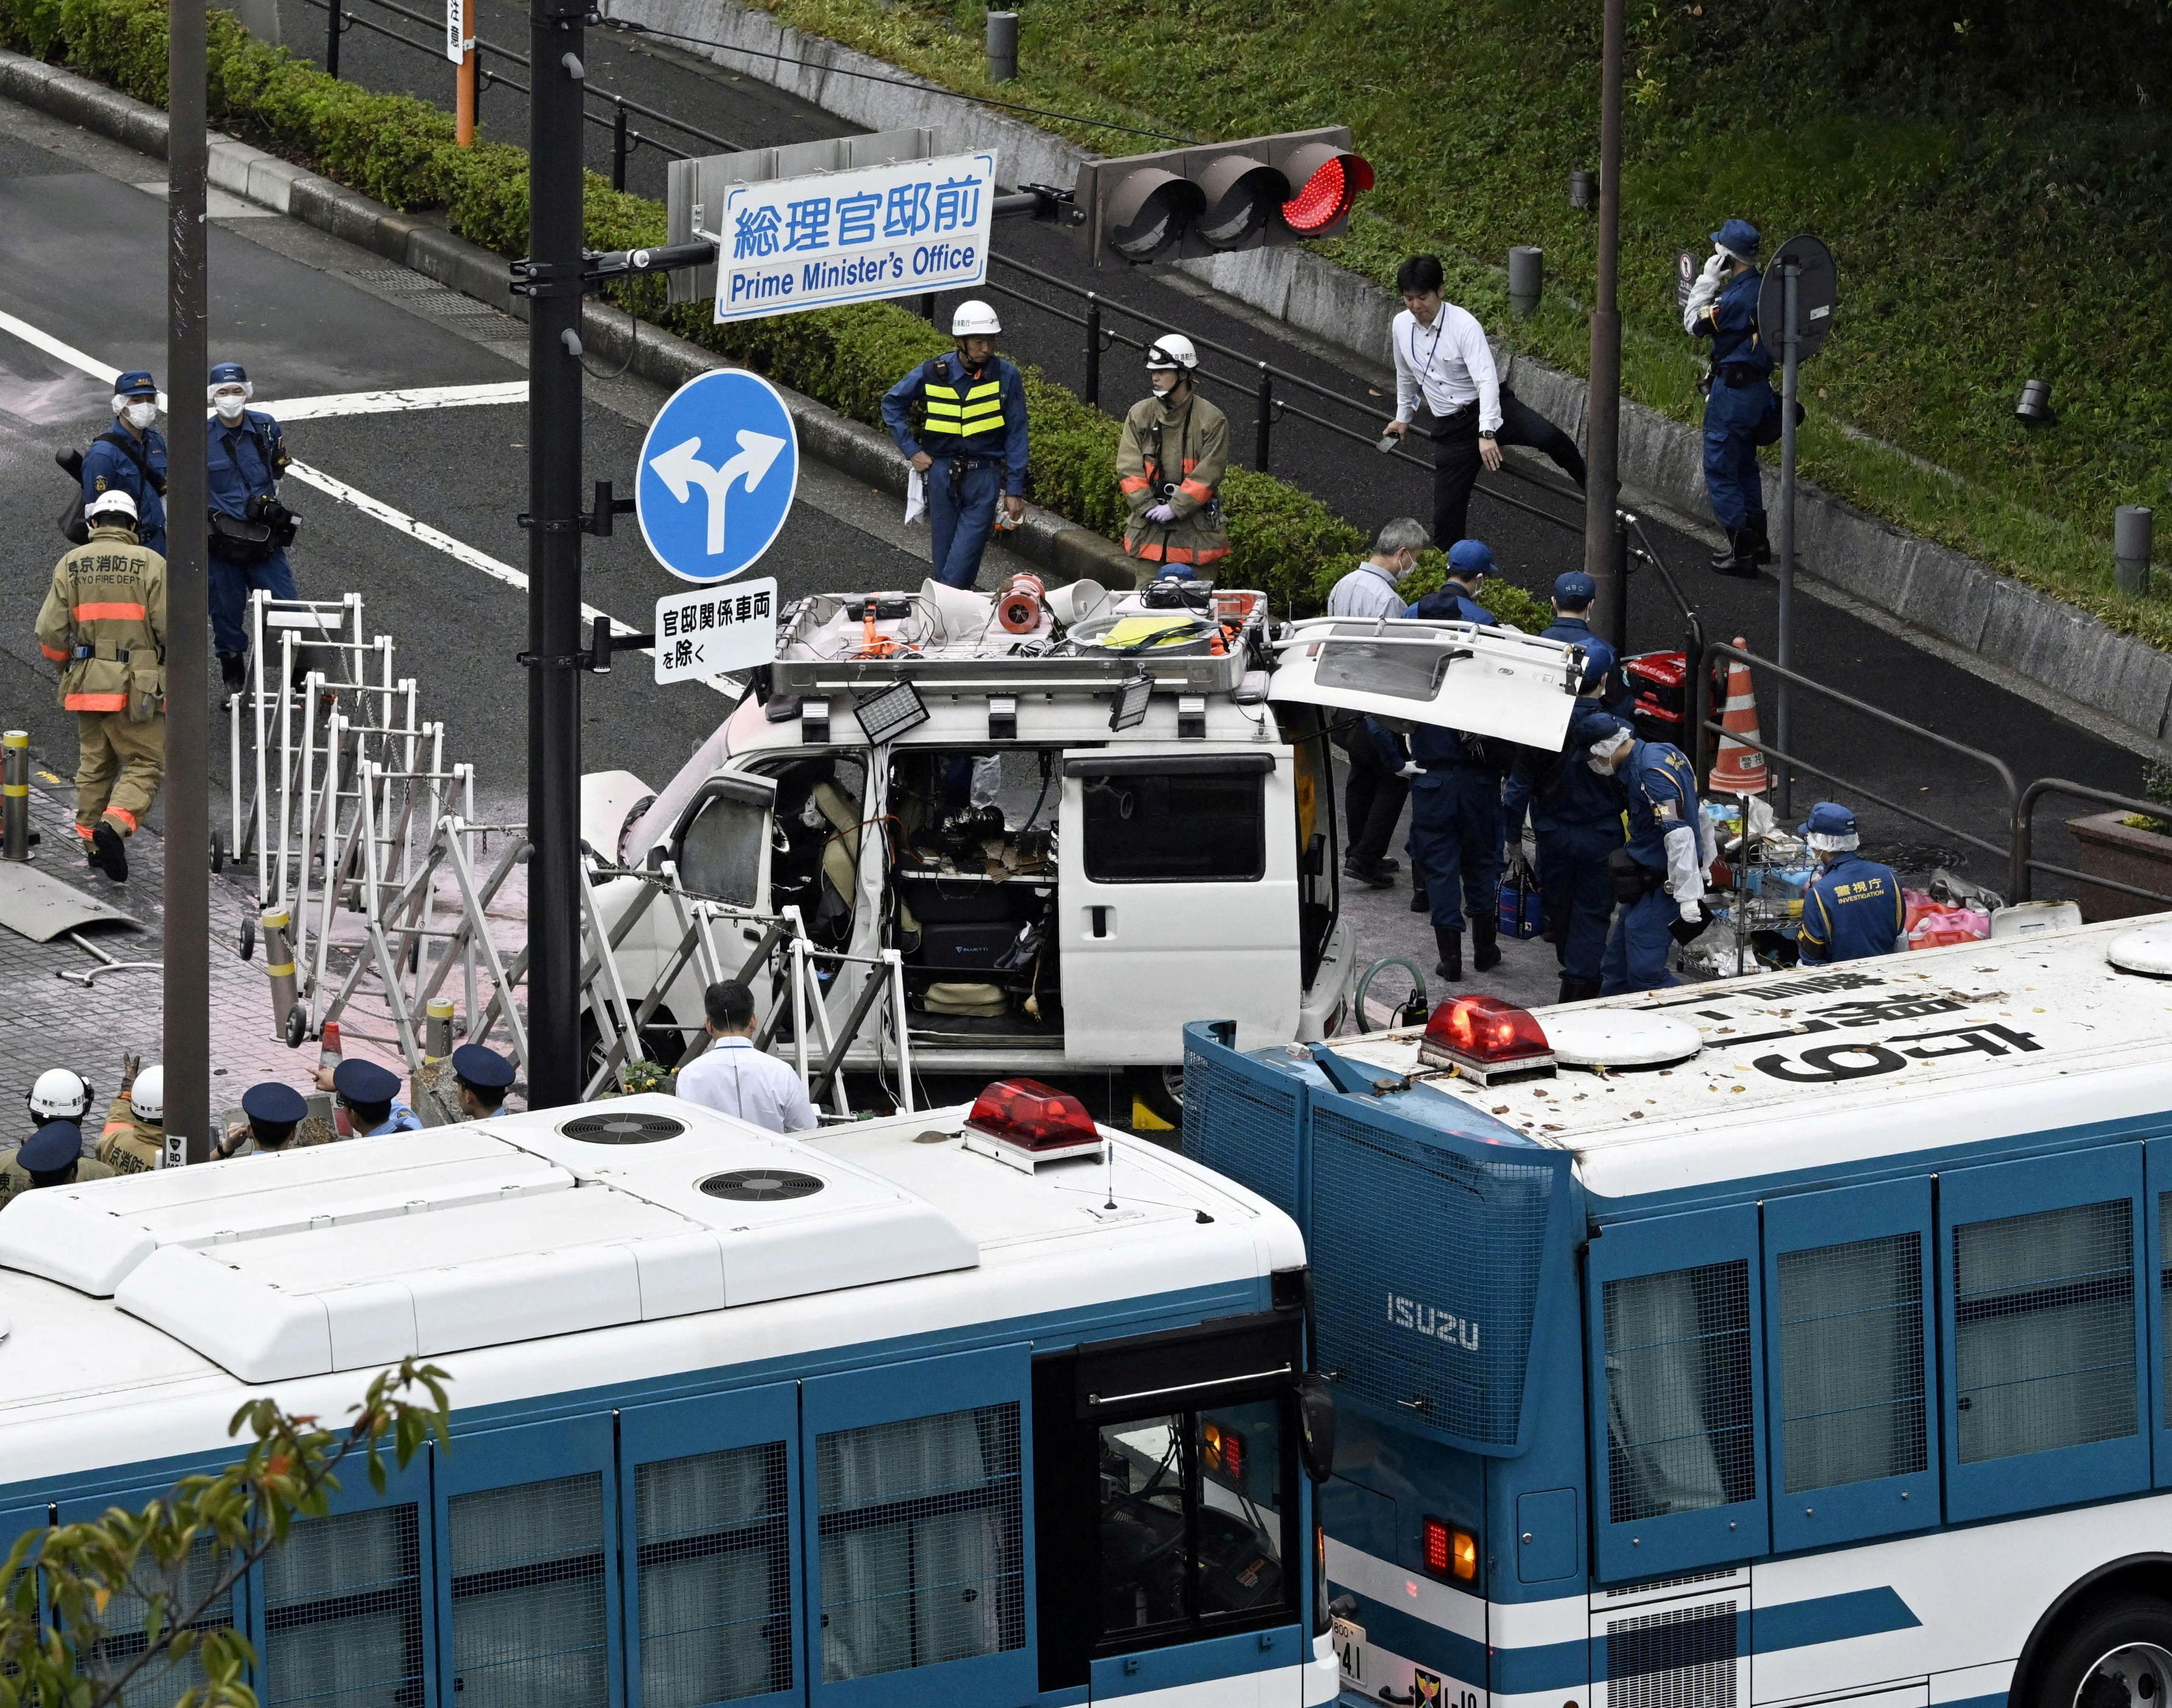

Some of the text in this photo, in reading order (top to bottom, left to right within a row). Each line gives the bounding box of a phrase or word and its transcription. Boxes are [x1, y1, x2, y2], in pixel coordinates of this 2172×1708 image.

[733, 174, 983, 261] 総理官邸前
[730, 243, 975, 303] Prime Minister's Office
[95, 575, 115, 584] FIRE
[116, 575, 141, 585] DEPT
[663, 590, 771, 637] 官邸関係車両
[663, 639, 704, 670] を除く
[1834, 878, 1882, 898] 警視庁
[1838, 889, 1885, 905] INVESTIGATION
[170, 1152, 181, 1162] BD
[1387, 1292, 1479, 1351] ISUZU
[1334, 1622, 1349, 1638] 800
